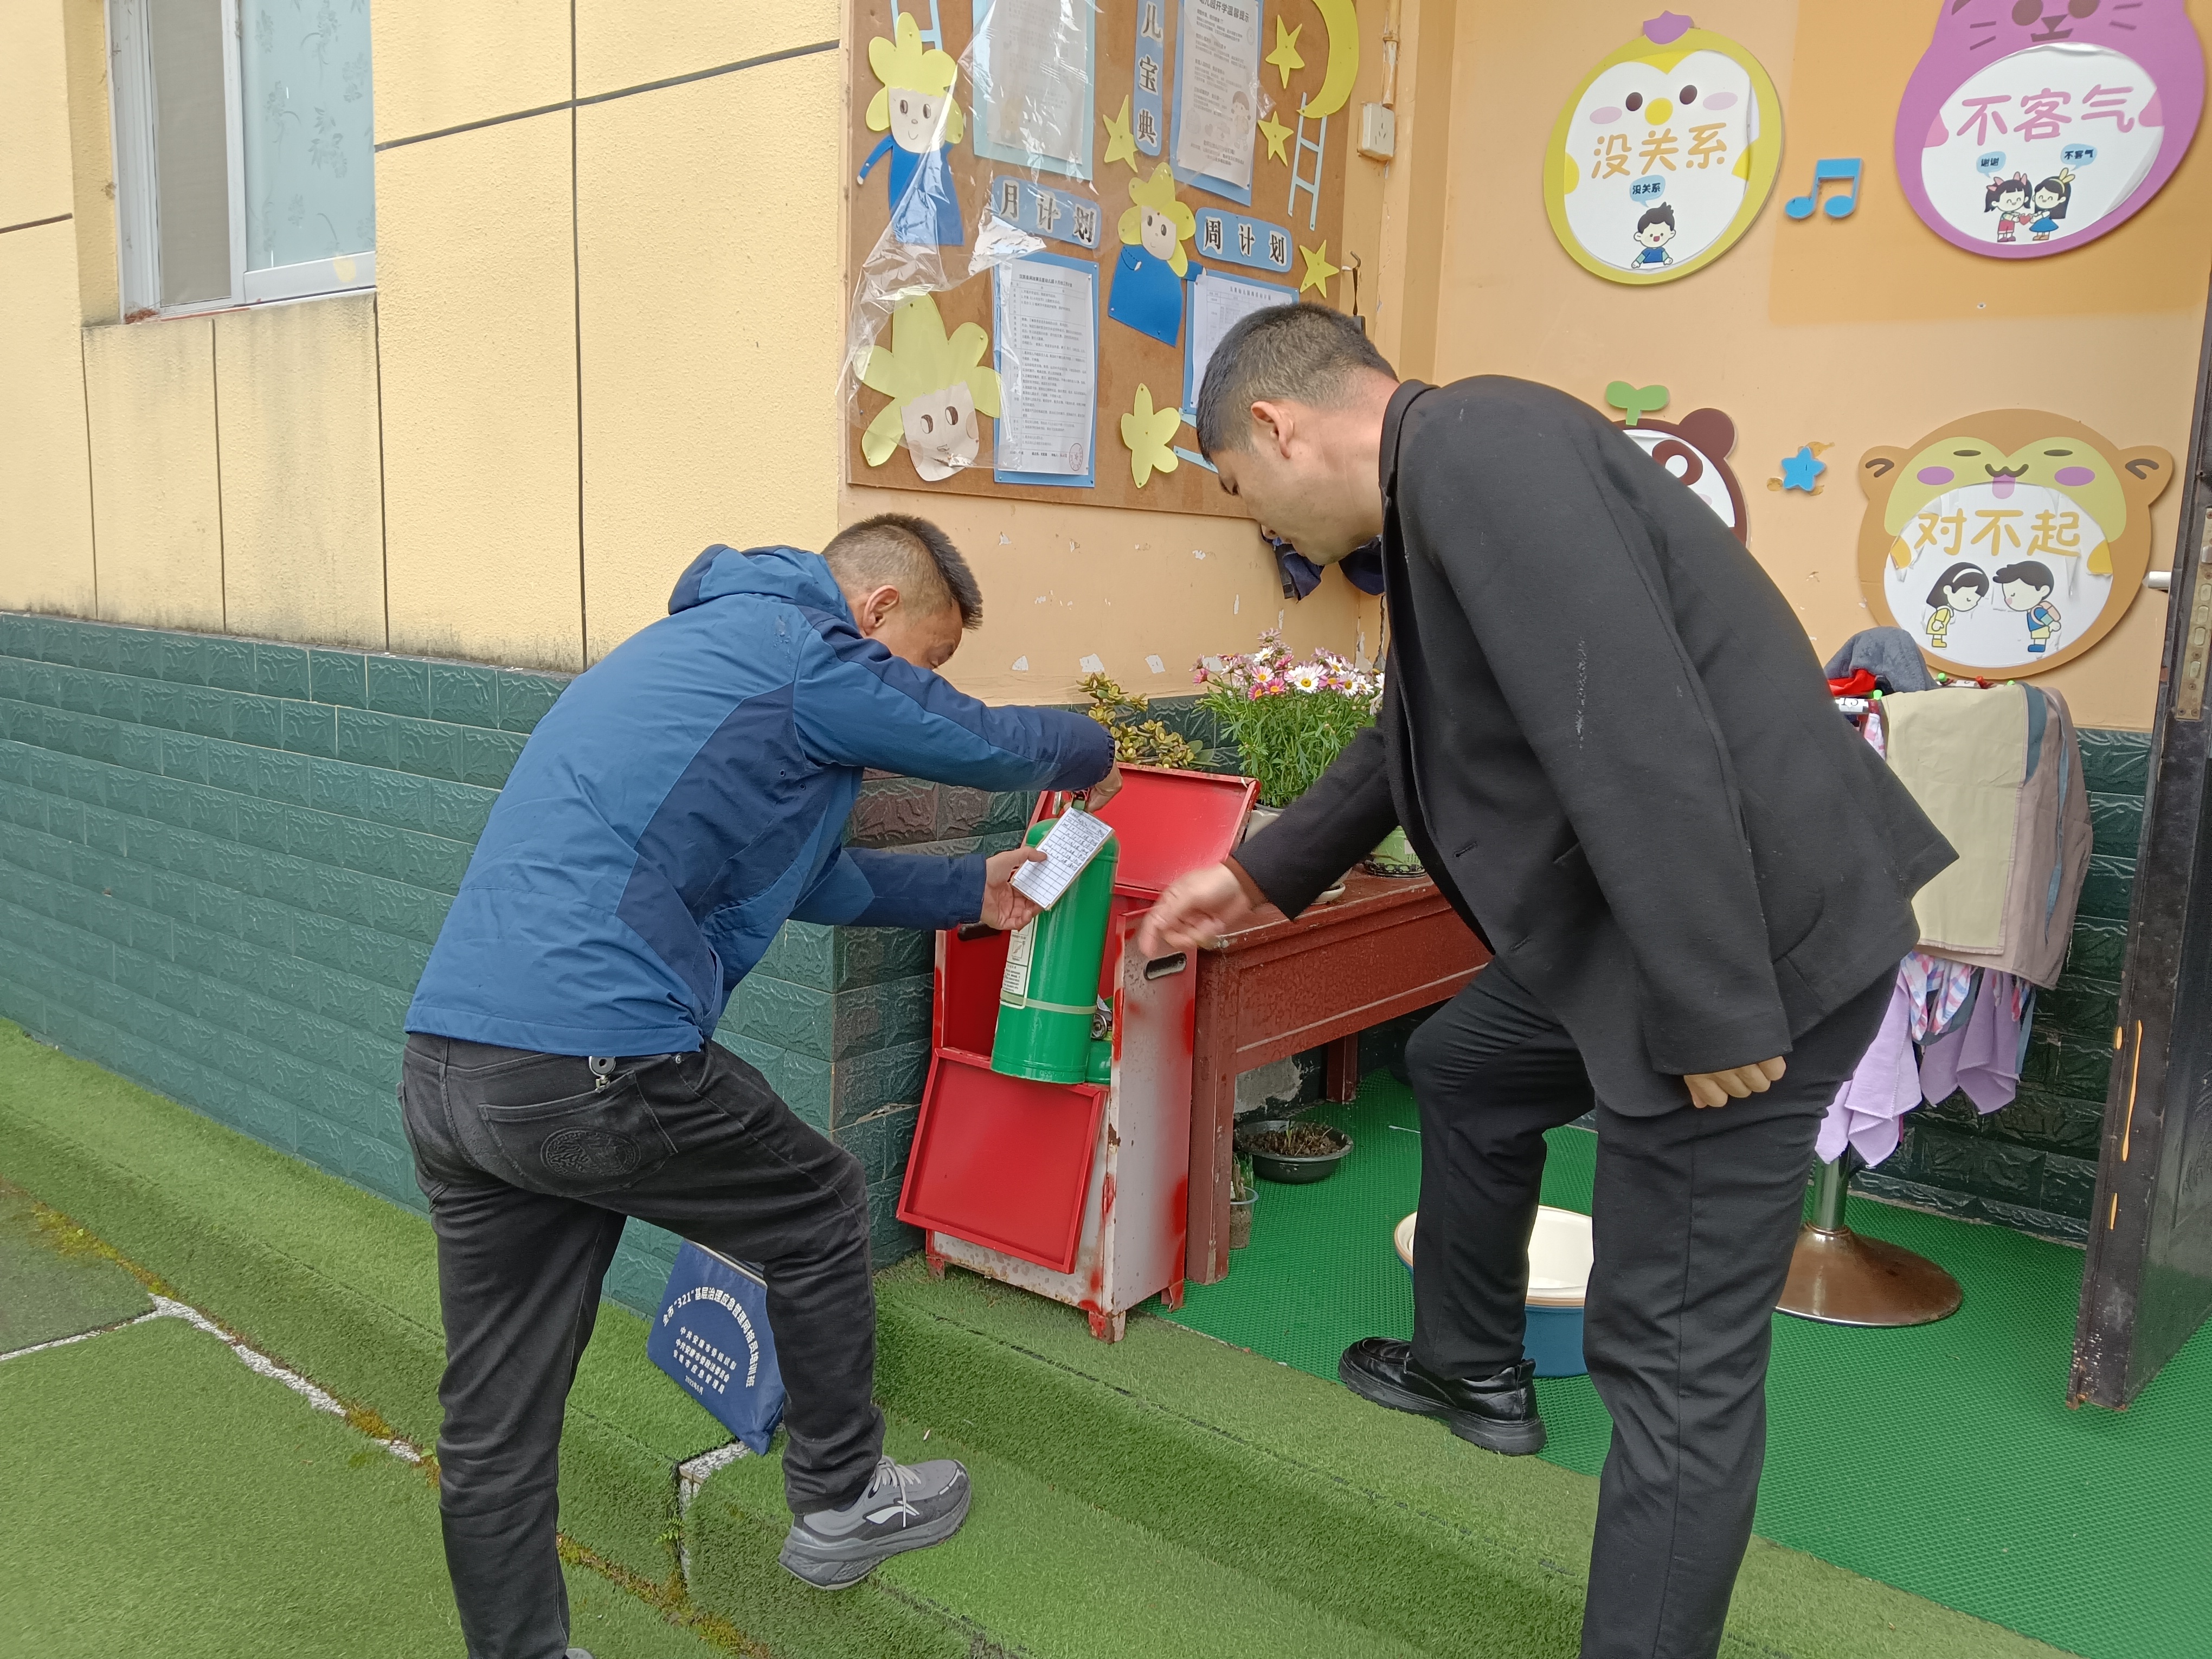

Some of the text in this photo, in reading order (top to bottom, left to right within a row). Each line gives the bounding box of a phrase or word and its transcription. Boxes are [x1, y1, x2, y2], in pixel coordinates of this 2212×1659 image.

[1137, 4, 1162, 144] 儿宝典
[1956, 84, 2135, 146] 不客气
[1591, 123, 1727, 179] 没关系
[1980, 157, 1999, 167] 谢谢
[2063, 149, 2094, 160] 不客气
[1632, 182, 1661, 195] 没关系
[1001, 183, 1095, 243] 月计划
[1204, 218, 1285, 265] 周计划
[1914, 507, 2081, 557] 对不起
[676, 1338, 730, 1383] 中共安康市委政法委员会
[680, 1326, 737, 1371] 中共安康市委组织部
[673, 1349, 725, 1395] 安康市应急管理局
